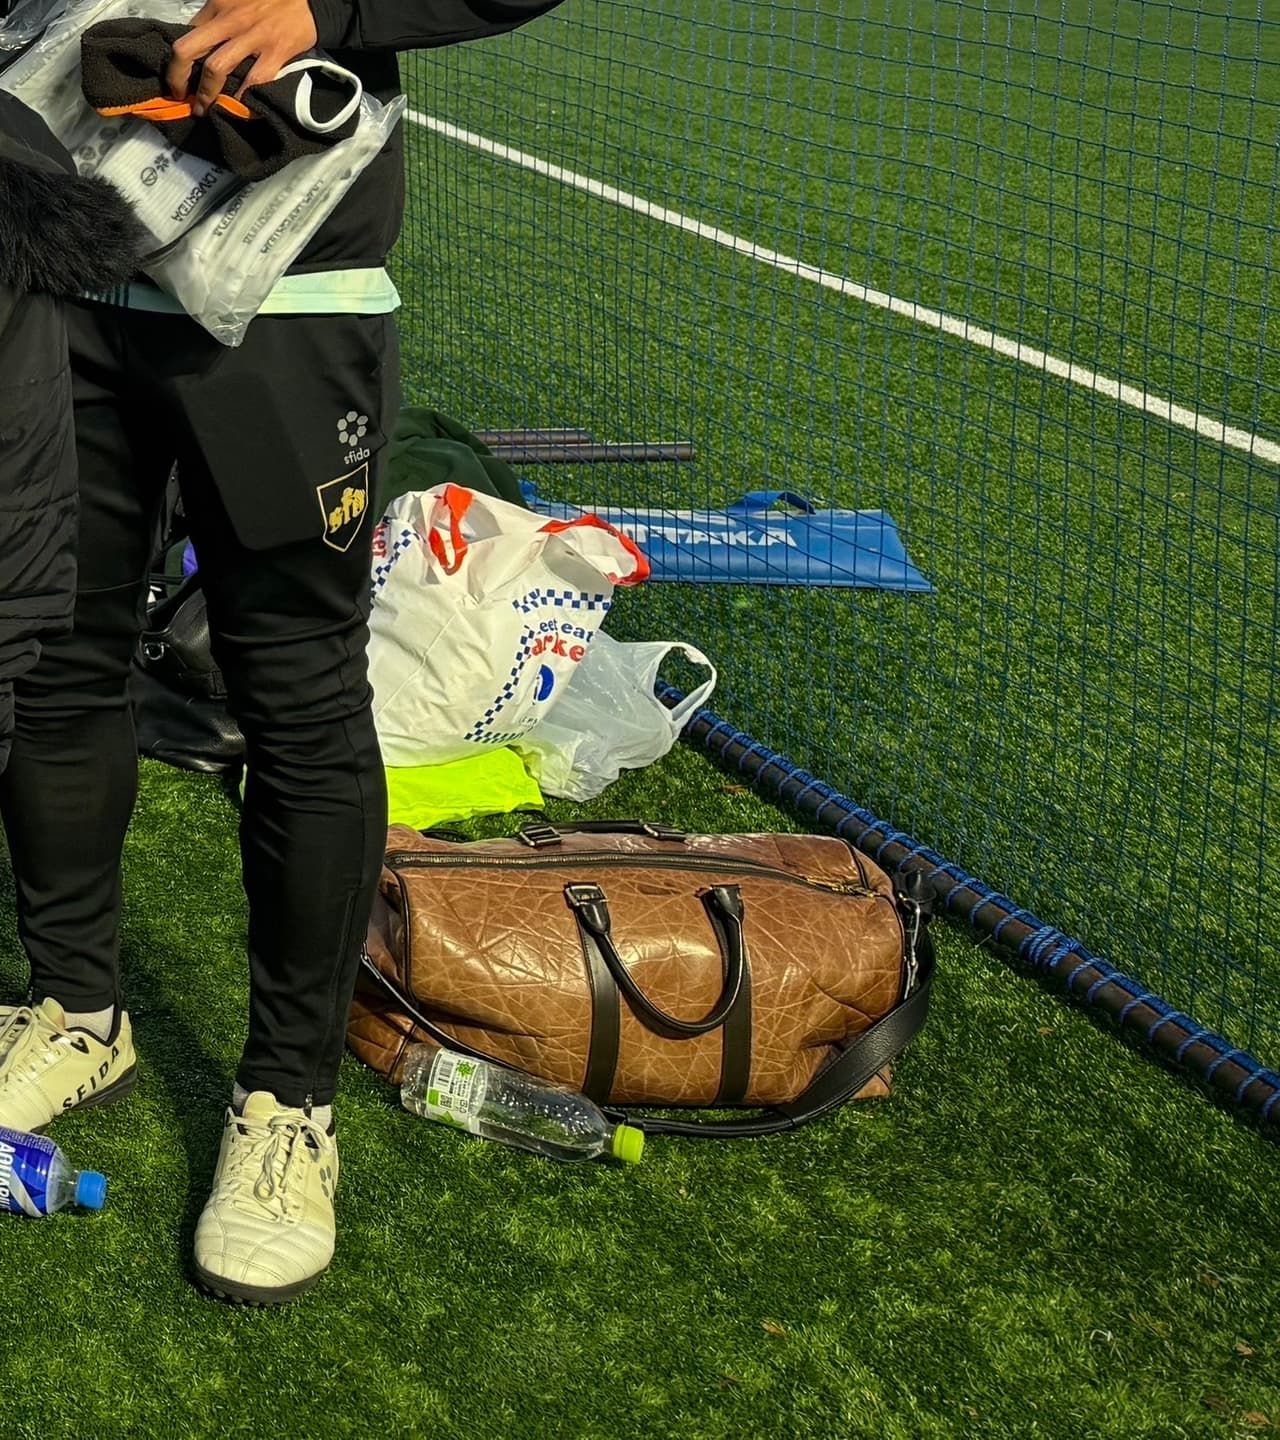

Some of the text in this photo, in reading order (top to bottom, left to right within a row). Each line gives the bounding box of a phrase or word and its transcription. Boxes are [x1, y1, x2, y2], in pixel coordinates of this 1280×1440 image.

[344, 447, 370, 465] sfida
[561, 622, 595, 643] eat
[530, 632, 586, 662] arke
